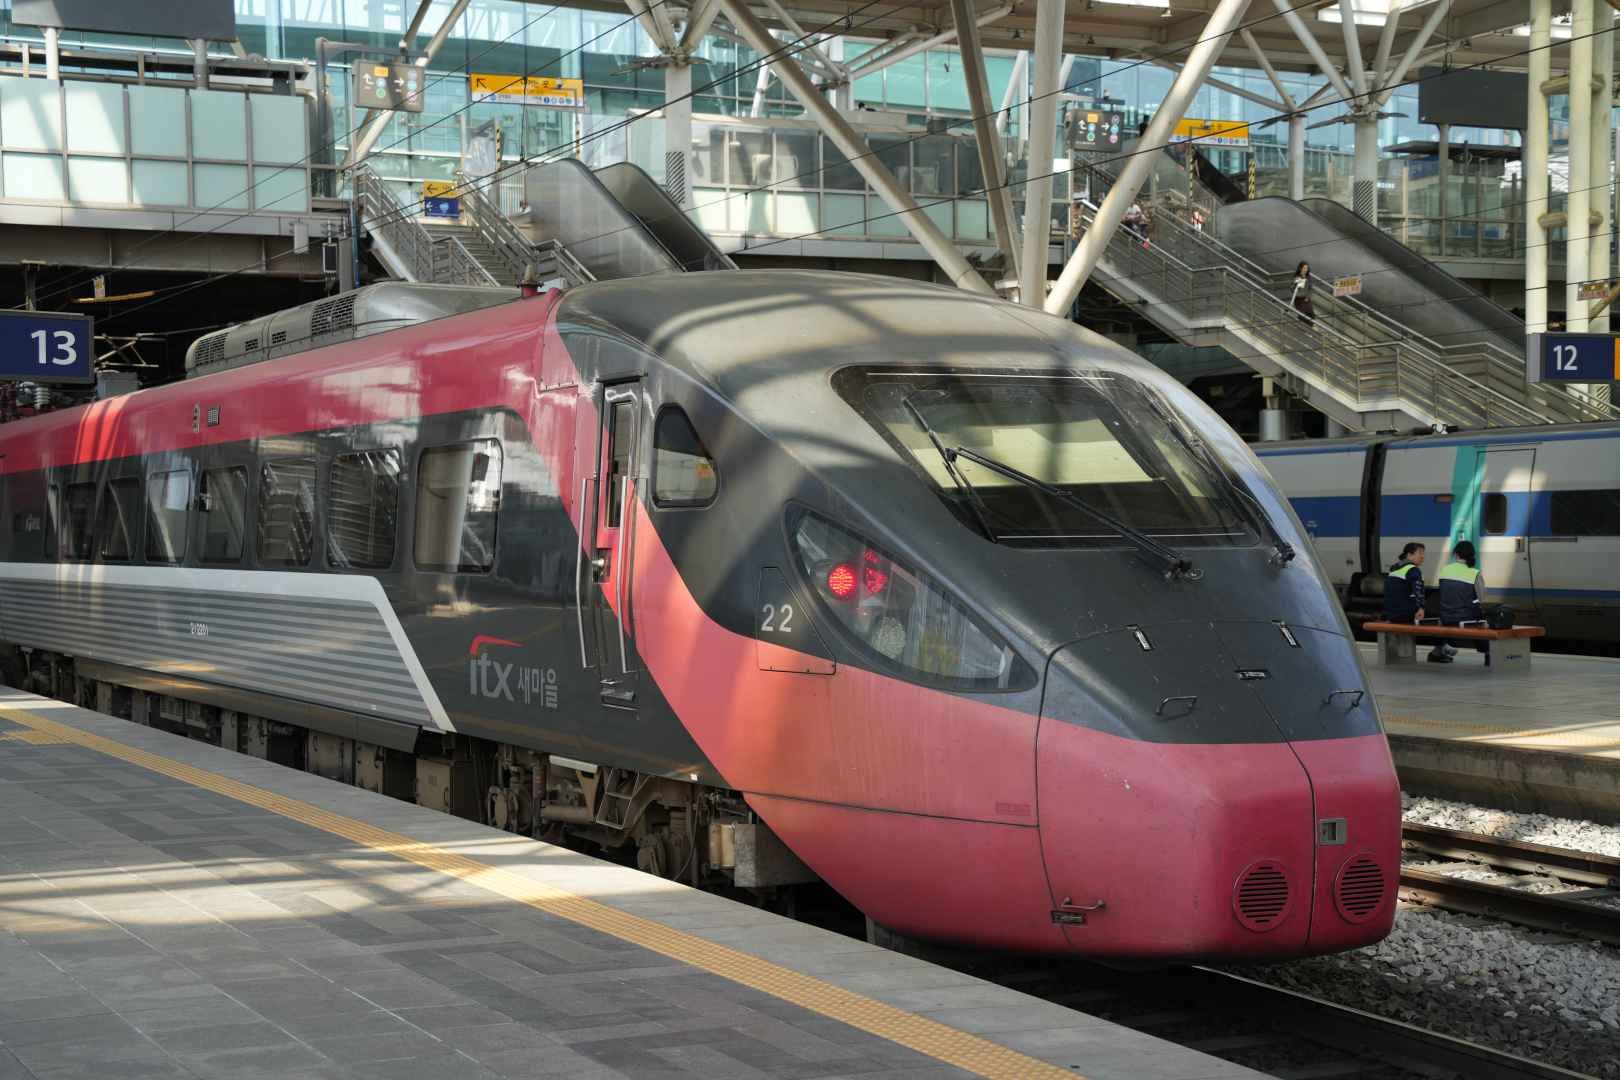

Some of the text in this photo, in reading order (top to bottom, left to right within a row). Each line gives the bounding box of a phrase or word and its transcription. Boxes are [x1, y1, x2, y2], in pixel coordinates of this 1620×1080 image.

[31, 329, 77, 366] 13
[1553, 344, 1578, 371] 12
[761, 603, 793, 633] 22
[518, 665, 558, 709] 새마을
